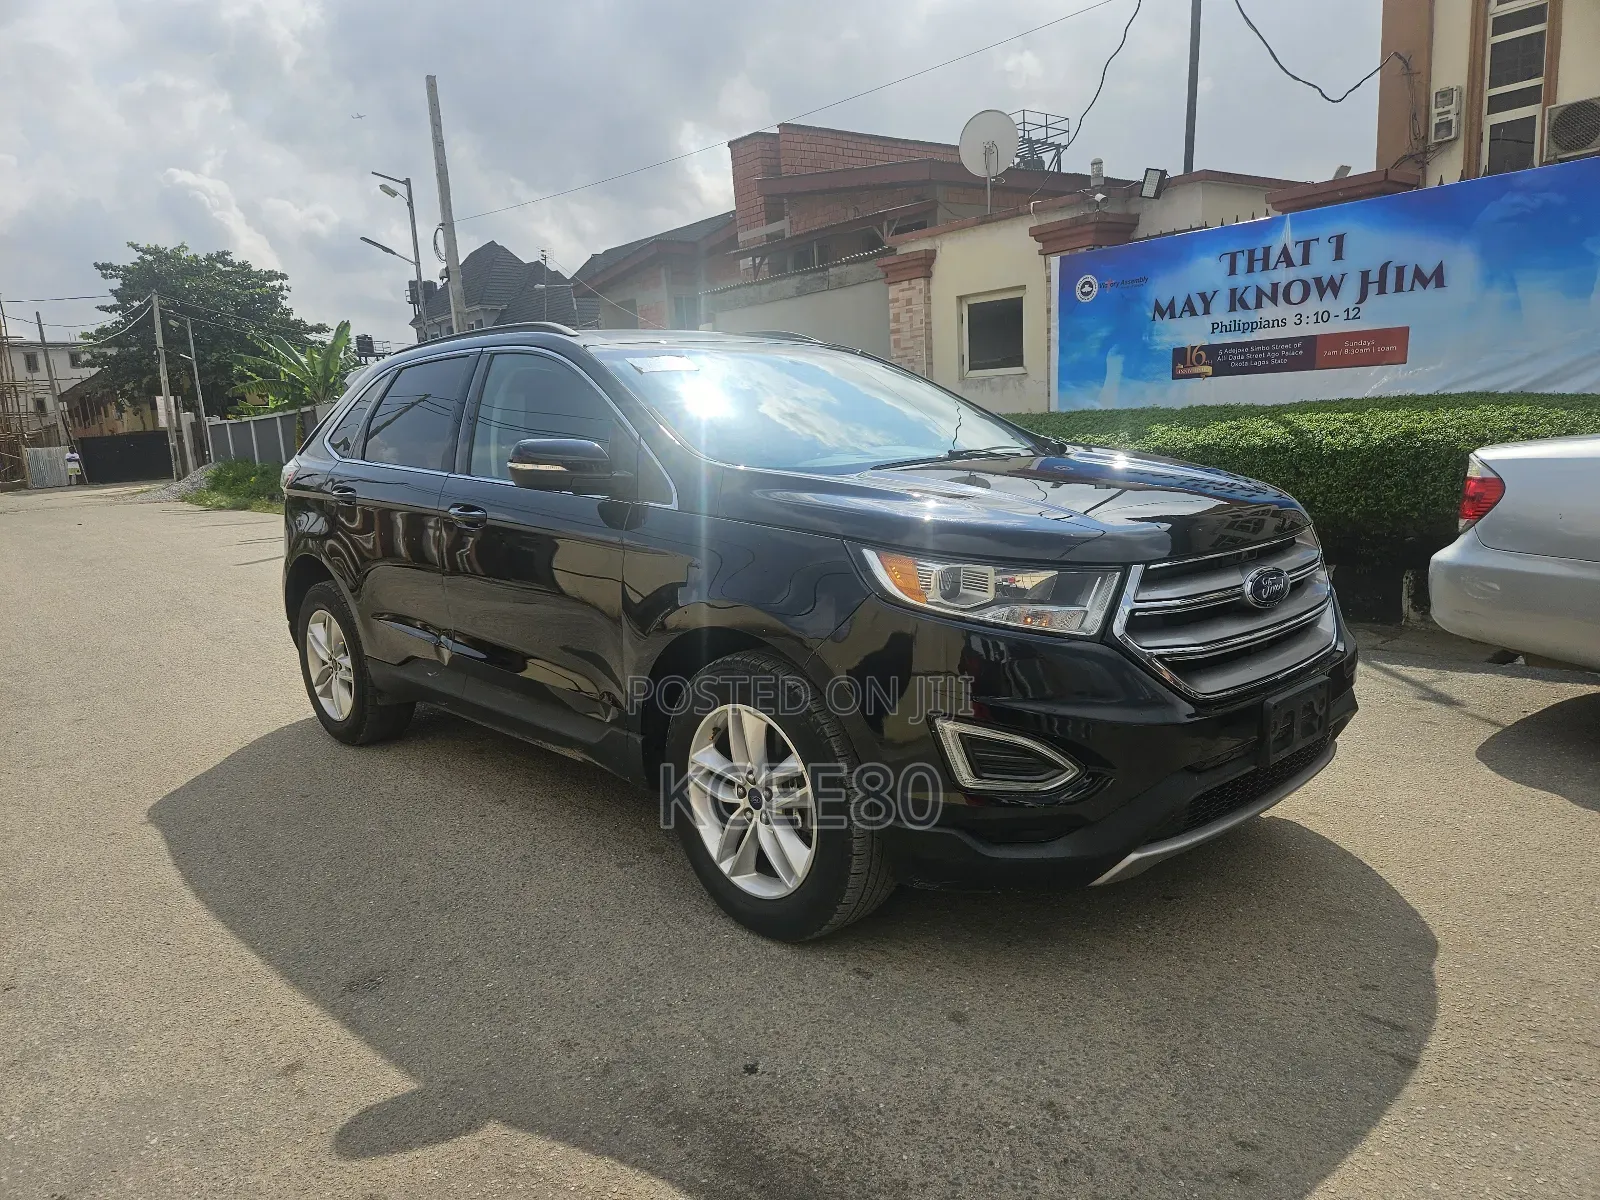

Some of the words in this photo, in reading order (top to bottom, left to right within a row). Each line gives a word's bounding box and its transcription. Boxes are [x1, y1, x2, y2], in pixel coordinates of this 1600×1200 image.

[1219, 238, 1319, 276] THAT
[1328, 233, 1347, 261] I
[1120, 276, 1149, 285] Assembly
[1151, 290, 1219, 322] MAY
[1228, 273, 1348, 313] KNOW
[1356, 260, 1447, 305] HIM
[1210, 317, 1287, 334] Philippians
[1343, 307, 1361, 321] 12
[1261, 576, 1284, 599] Ford
